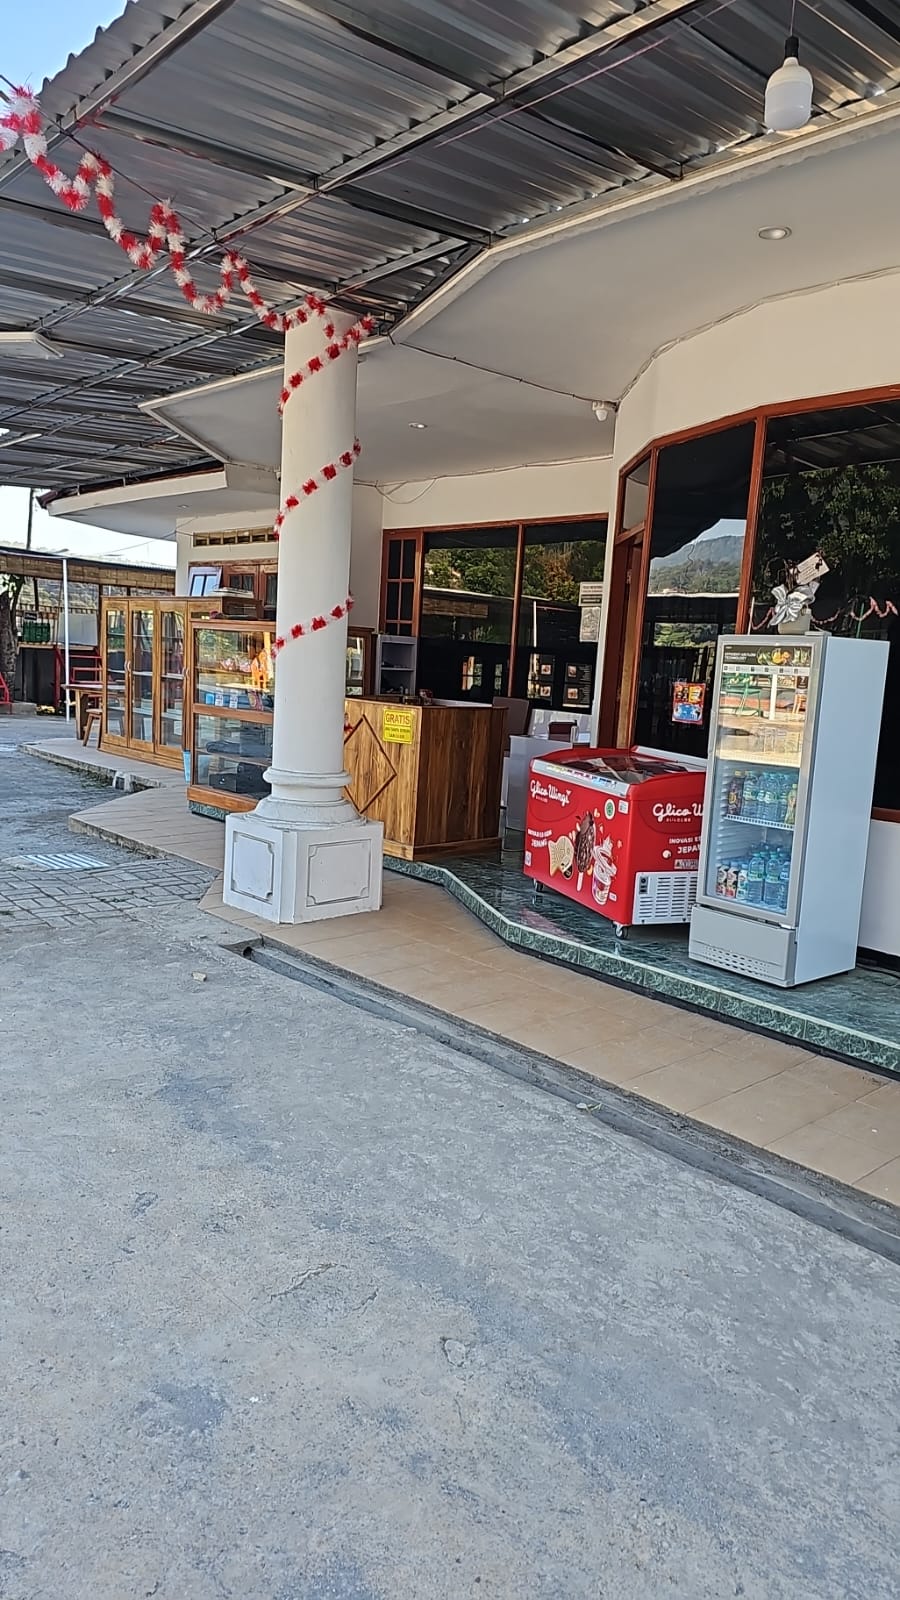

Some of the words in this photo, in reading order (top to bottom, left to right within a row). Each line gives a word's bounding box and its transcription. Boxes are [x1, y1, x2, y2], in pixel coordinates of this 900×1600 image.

[385, 713, 410, 725] GRATIS
[530, 780, 548, 798] Glico
[652, 802, 692, 822] Glico
